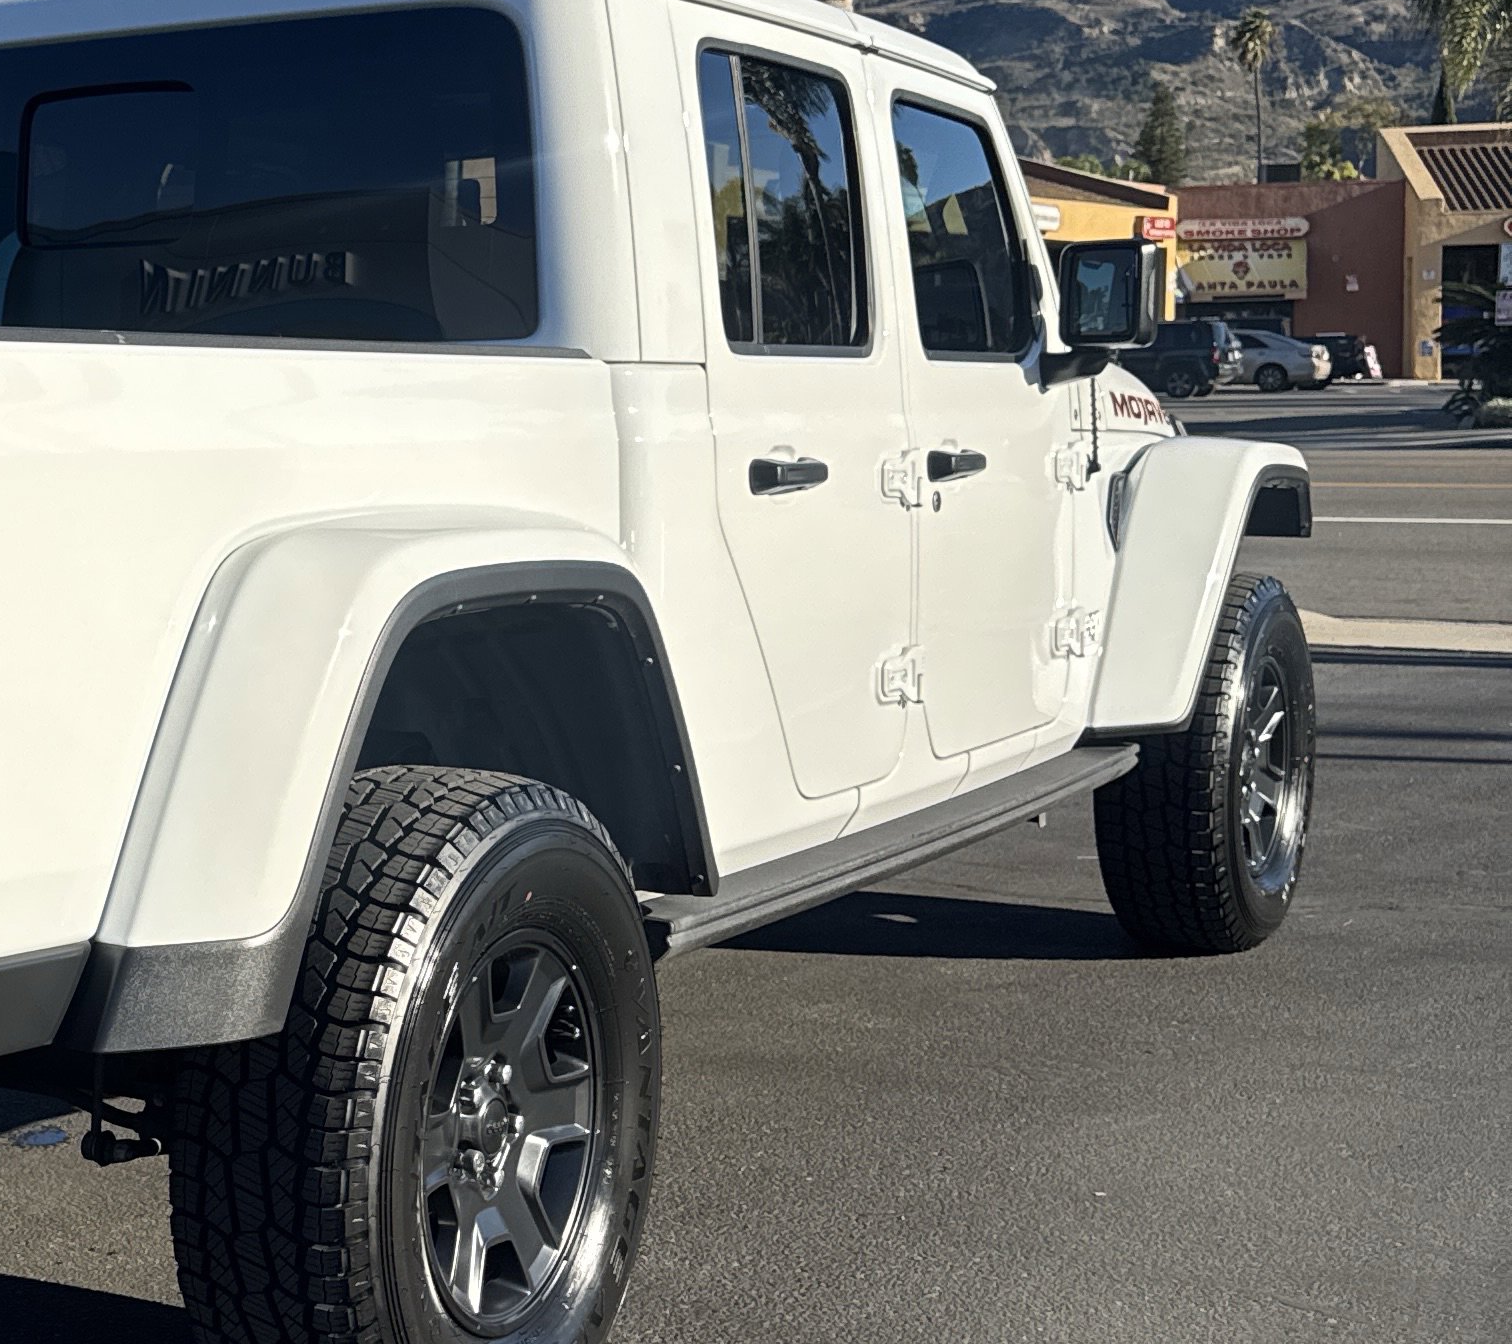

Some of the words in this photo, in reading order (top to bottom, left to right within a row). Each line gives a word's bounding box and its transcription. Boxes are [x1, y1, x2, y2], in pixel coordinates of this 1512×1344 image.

[1183, 228, 1246, 238] SMOKE
[1251, 226, 1302, 237] SHOP
[1251, 241, 1292, 253] LOCA
[1195, 280, 1238, 292] ANTA
[1245, 278, 1300, 291] PAULA
[1108, 390, 1165, 426] MOJAV
